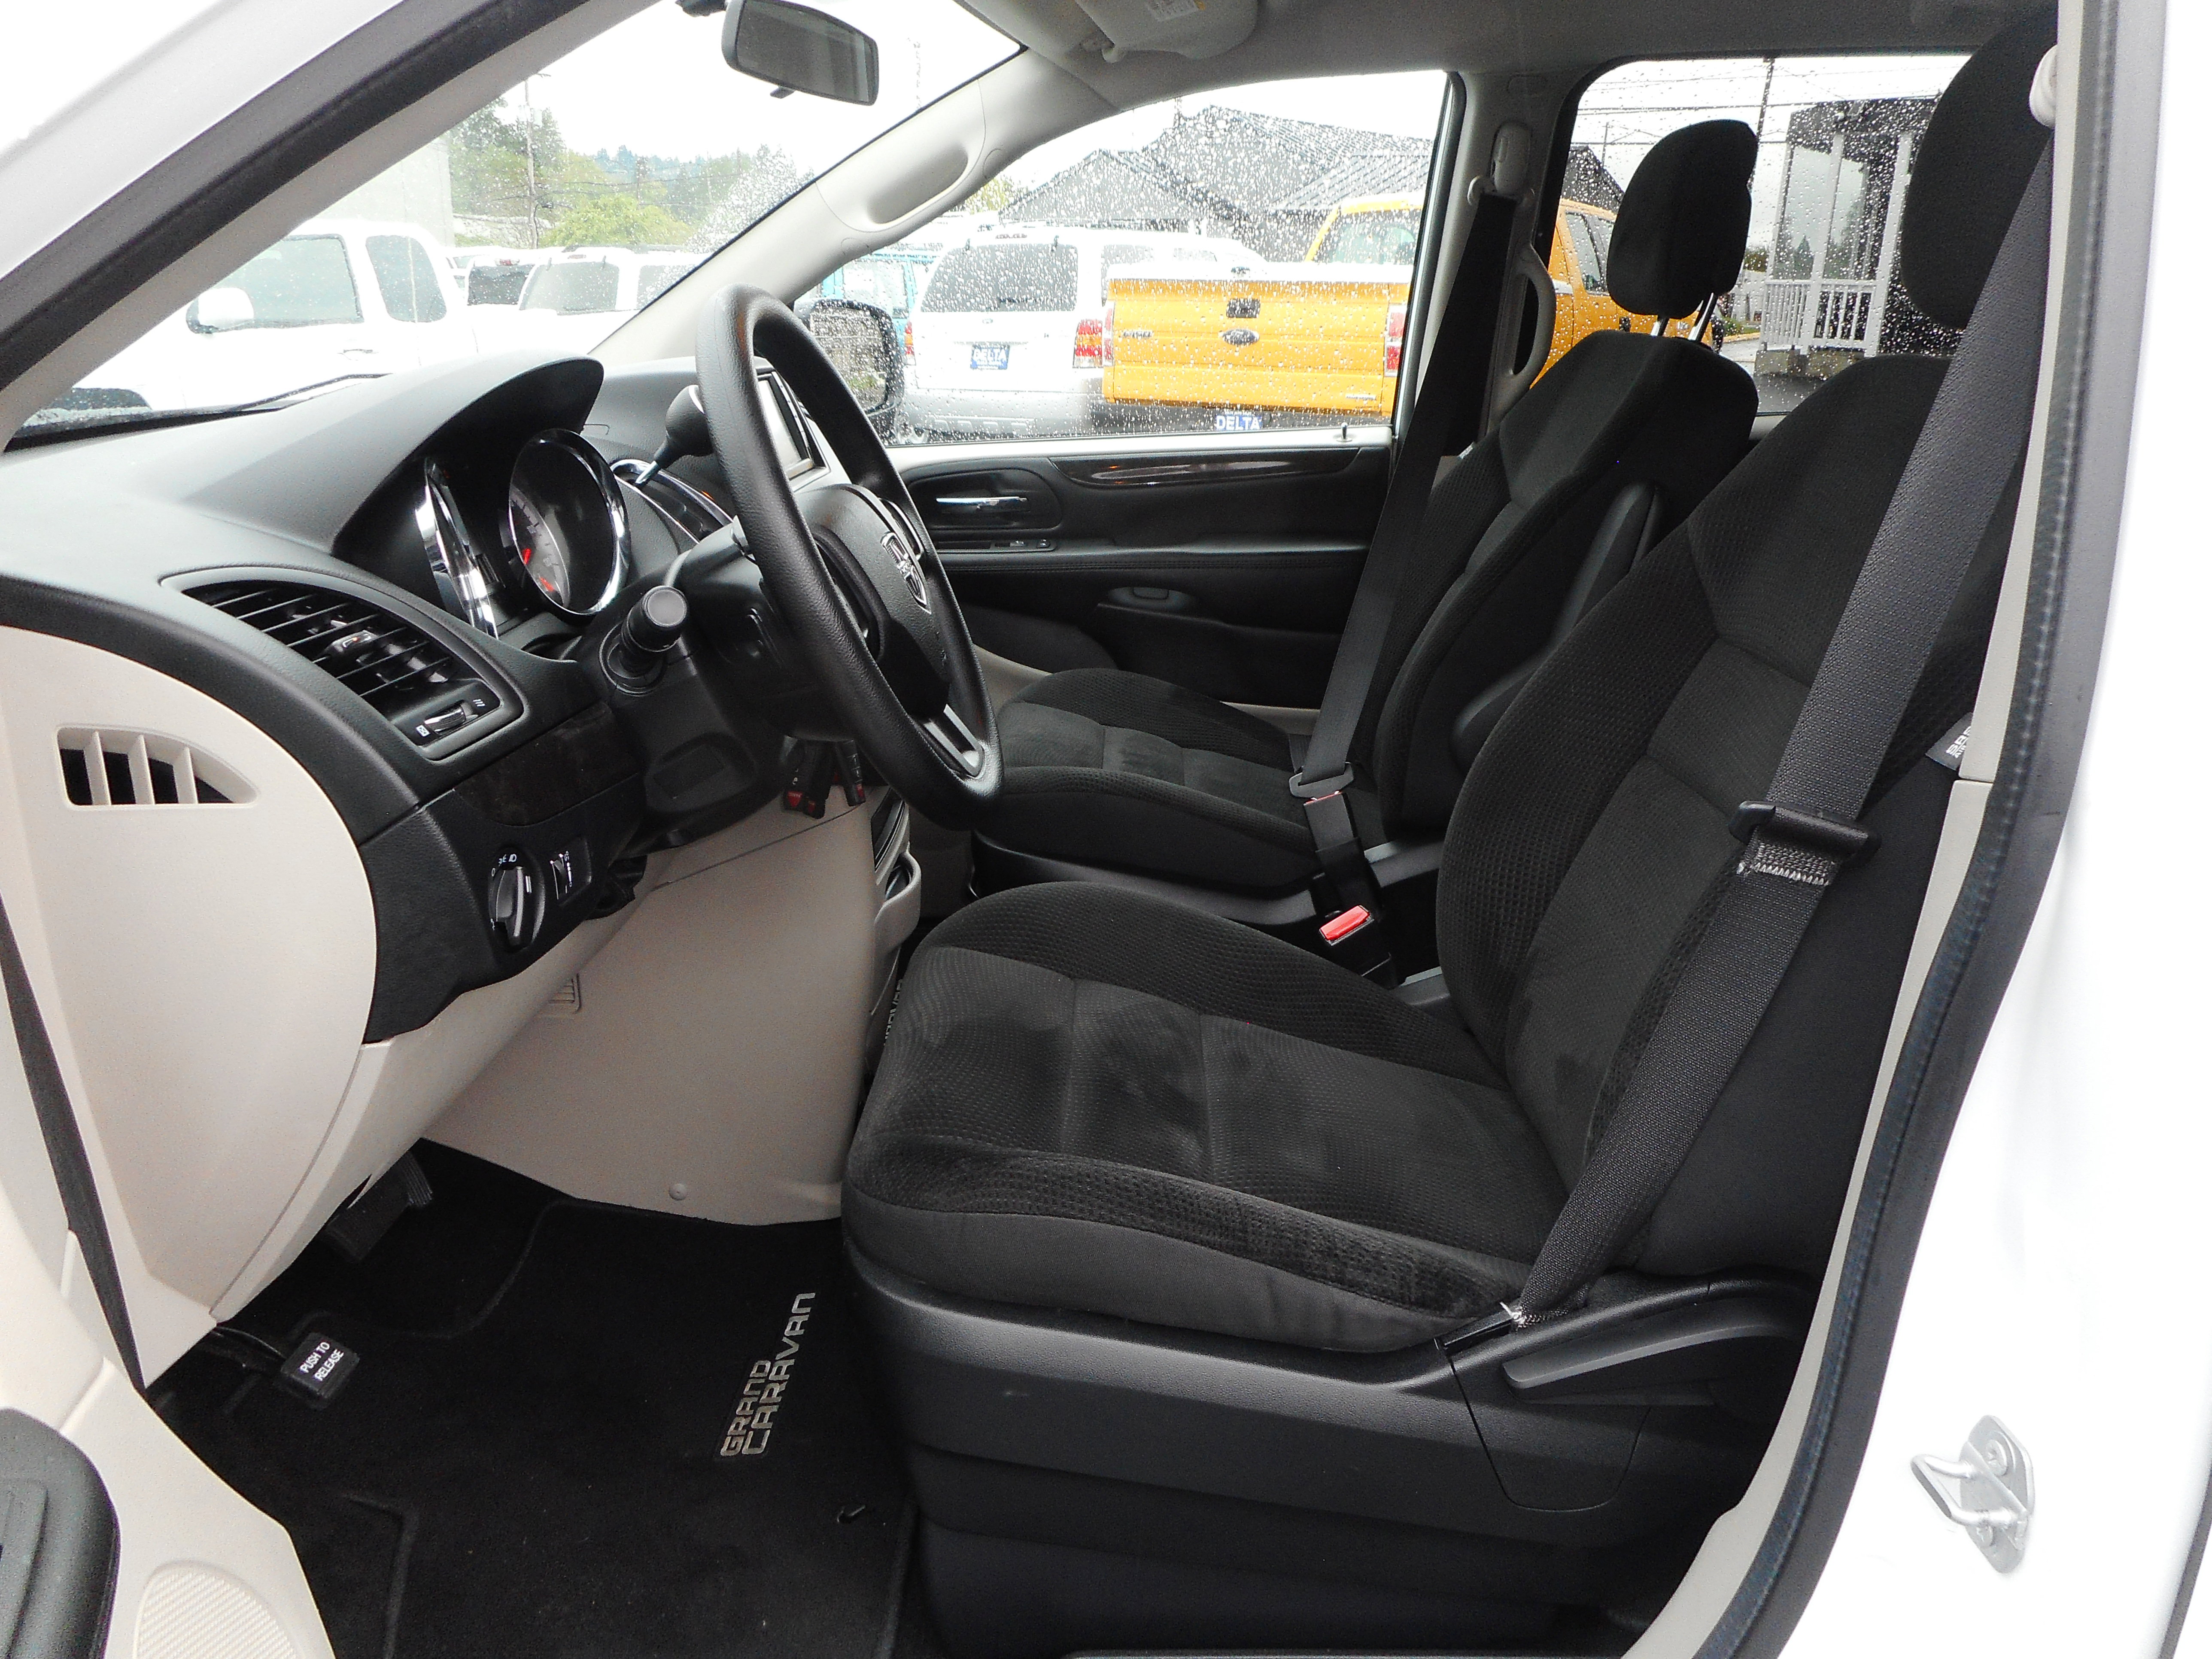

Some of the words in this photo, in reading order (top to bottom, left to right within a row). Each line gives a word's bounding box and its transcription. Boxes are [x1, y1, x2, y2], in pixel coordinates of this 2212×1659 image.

[973, 348, 1007, 362] DELTA
[1216, 415, 1260, 430] DELTA
[300, 1352, 322, 1373] PUSH
[316, 1342, 330, 1353] TO
[314, 1349, 344, 1382] RELEASE
[741, 1292, 816, 1455] CARAVAN
[720, 1359, 771, 1456] GRAND
